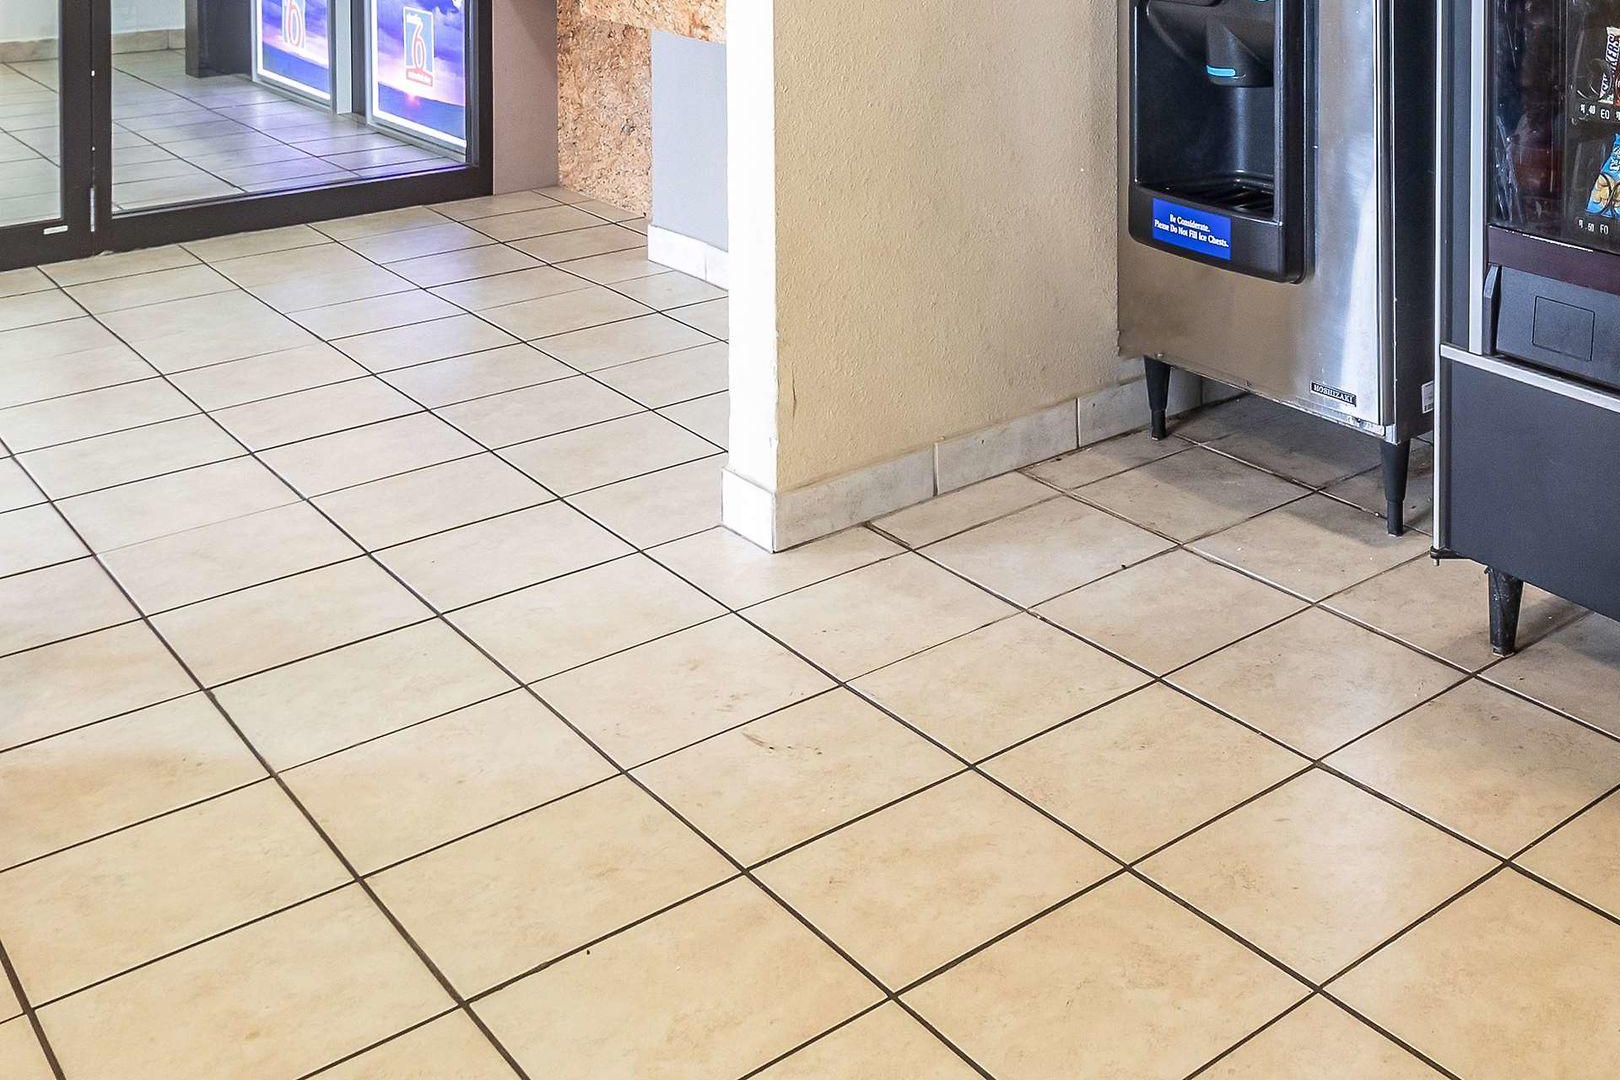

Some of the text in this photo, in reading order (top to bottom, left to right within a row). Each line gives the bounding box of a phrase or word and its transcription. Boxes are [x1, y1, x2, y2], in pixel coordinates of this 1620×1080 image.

[1169, 214, 1176, 223] Be
[1170, 224, 1177, 233] Do
[1178, 226, 1188, 236] Not
